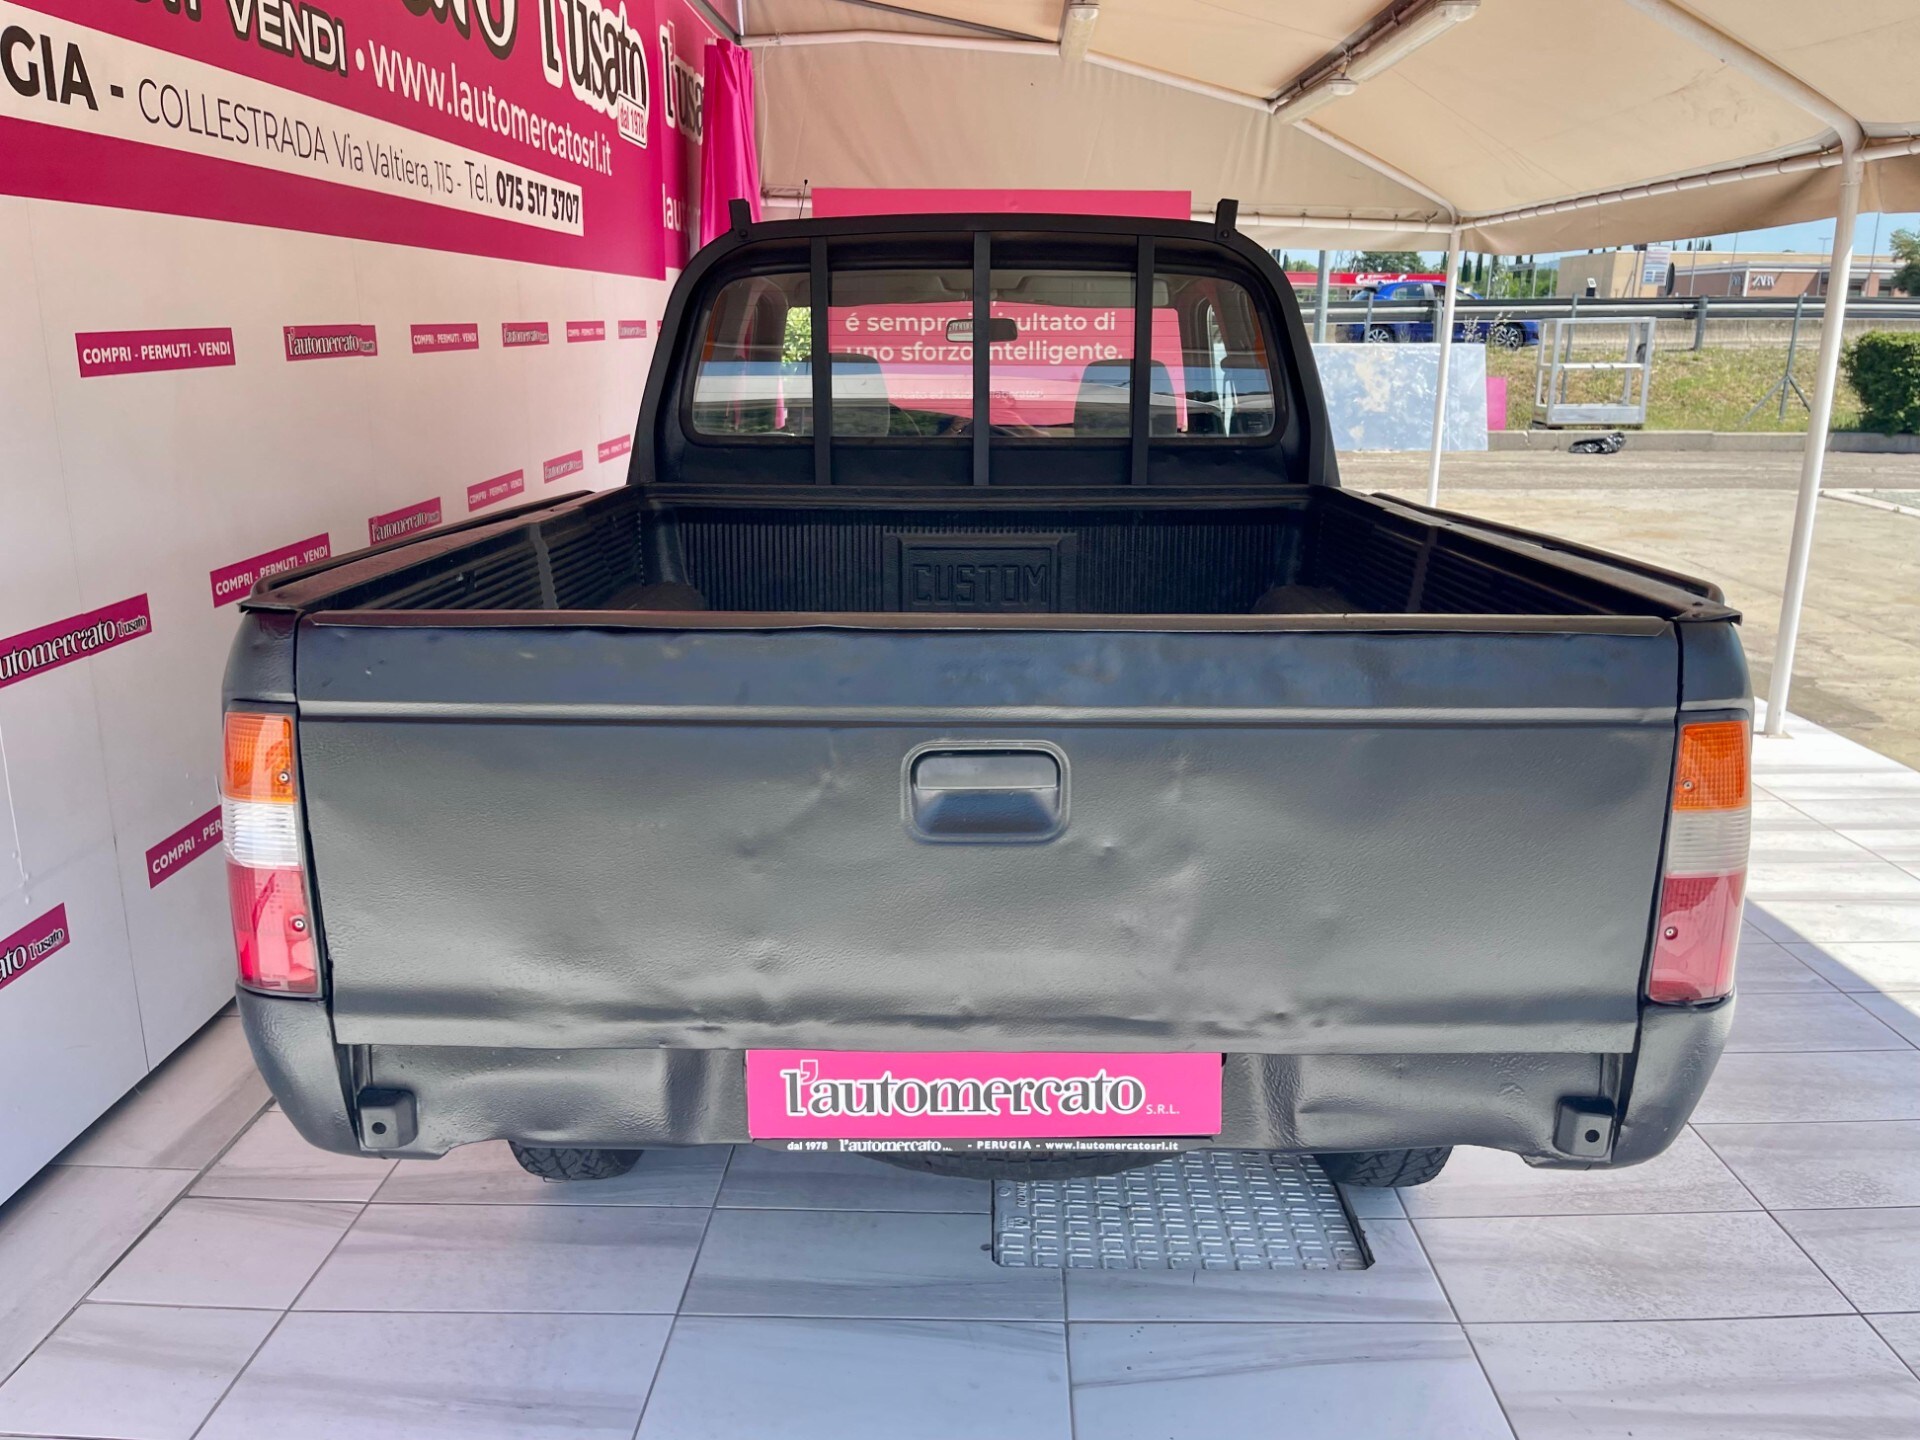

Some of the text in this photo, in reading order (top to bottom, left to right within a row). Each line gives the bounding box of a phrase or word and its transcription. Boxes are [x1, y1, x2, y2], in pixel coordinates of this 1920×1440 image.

[368, 39, 613, 177] www.lautomercatosrl.it
[138, 78, 329, 165] COLLESTRADA
[332, 130, 364, 173] Via
[367, 140, 433, 195] Valtiera,
[434, 160, 454, 195] 115
[464, 160, 493, 204] Tel.
[496, 170, 524, 212] 075
[527, 179, 548, 217] 517
[551, 188, 580, 225] 3707
[845, 313, 860, 332] é
[1093, 311, 1116, 332] di
[82, 346, 132, 365] COMPRI
[140, 342, 192, 361] PERMUTI
[197, 340, 232, 357] VENDI
[901, 341, 973, 362] sforzo
[989, 340, 1124, 365] ntelligente.
[215, 572, 253, 596] COMPRI
[260, 556, 298, 578] PERMUTI
[303, 545, 328, 563] VENDI
[911, 563, 1048, 606] CUSTOM
[0, 618, 116, 681] utomercato
[152, 836, 196, 874] COMPRI
[780, 1058, 1181, 1117] l'automercato S.R.L.
[787, 1140, 803, 1151] dal
[805, 1141, 829, 1151] 1978
[838, 1138, 942, 1152] l'automercato
[976, 1140, 1032, 1150] PERUGIA
[1045, 1141, 1179, 1151] www.lautomercatosrl.it
